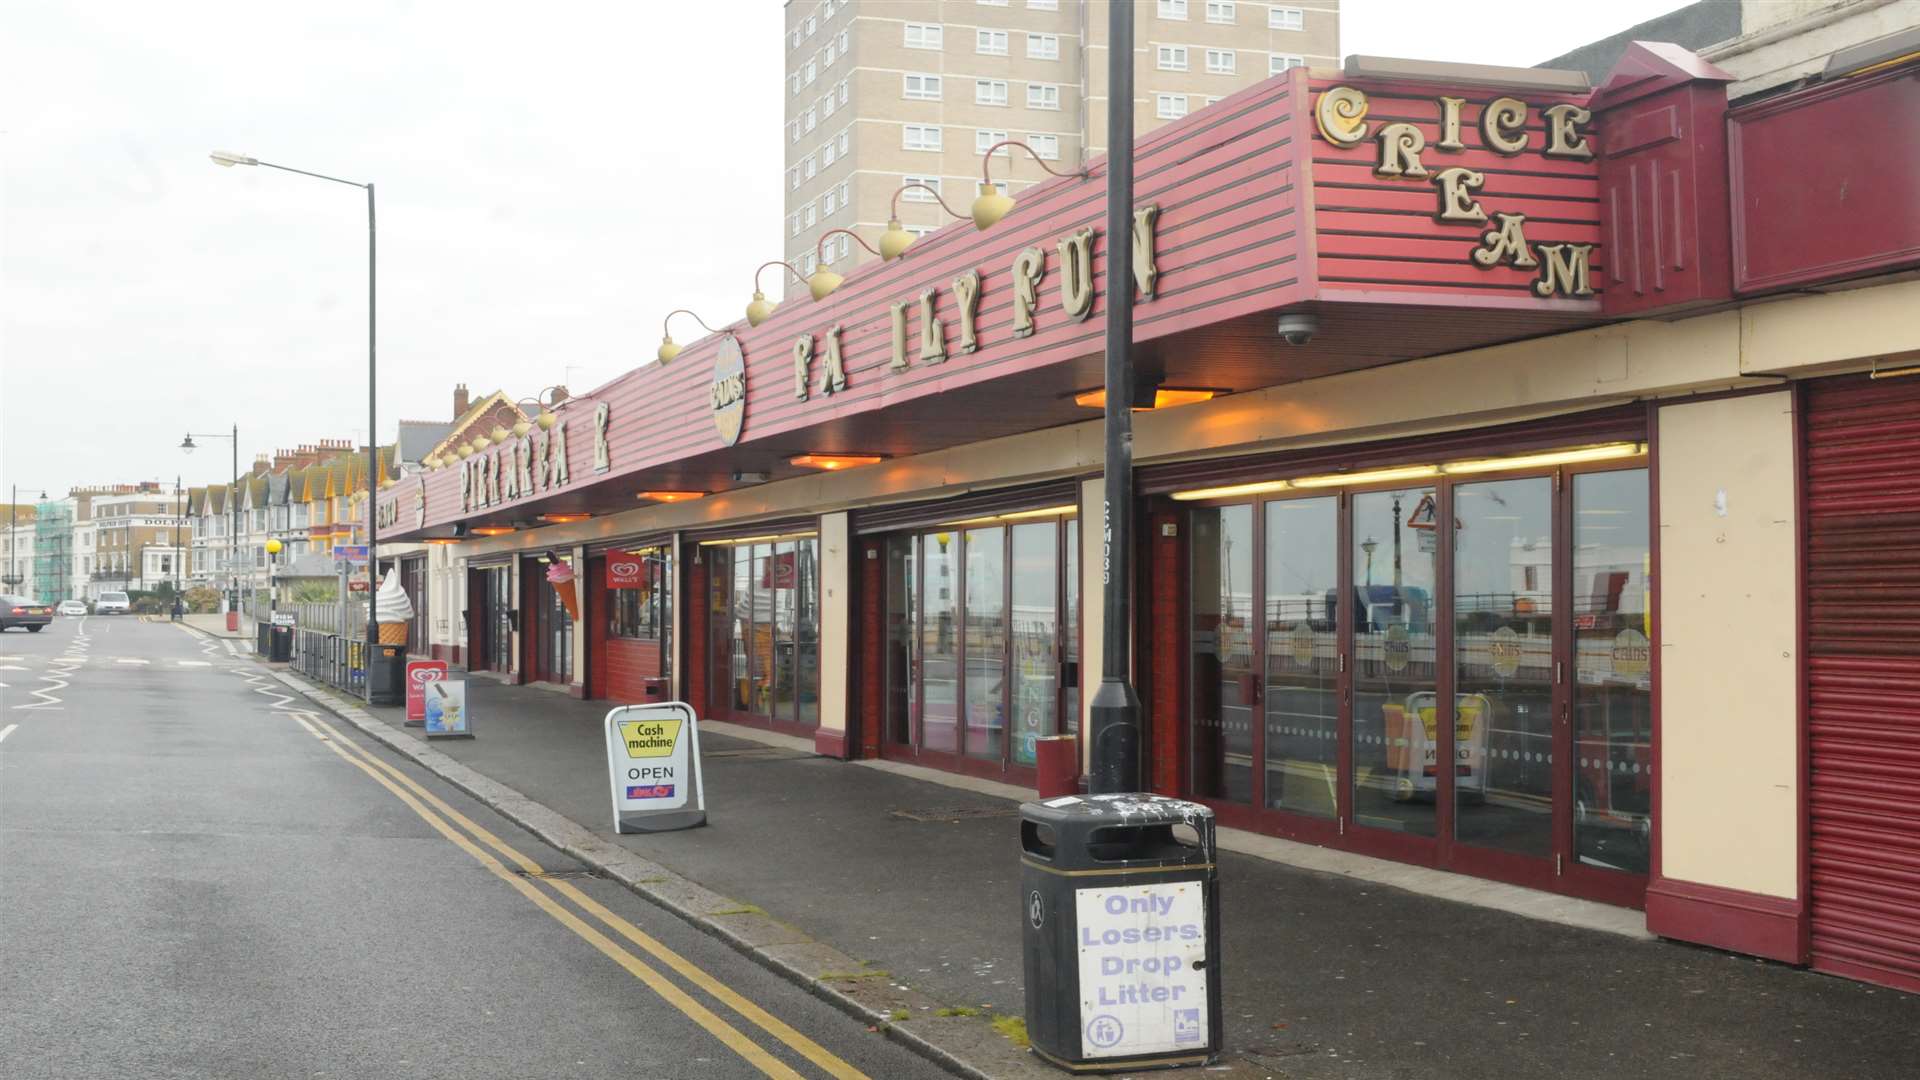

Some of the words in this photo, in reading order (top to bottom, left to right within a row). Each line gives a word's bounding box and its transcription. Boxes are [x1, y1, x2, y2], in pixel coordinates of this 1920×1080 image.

[1437, 96, 1593, 160] ICE
[637, 724, 664, 737] Cash
[628, 737, 673, 749] machine
[628, 767, 674, 780] OPEN
[1105, 893, 1175, 916] Only
[1082, 924, 1198, 946] Losers
[1101, 955, 1182, 977] Drop
[1098, 982, 1186, 1006] Litter
